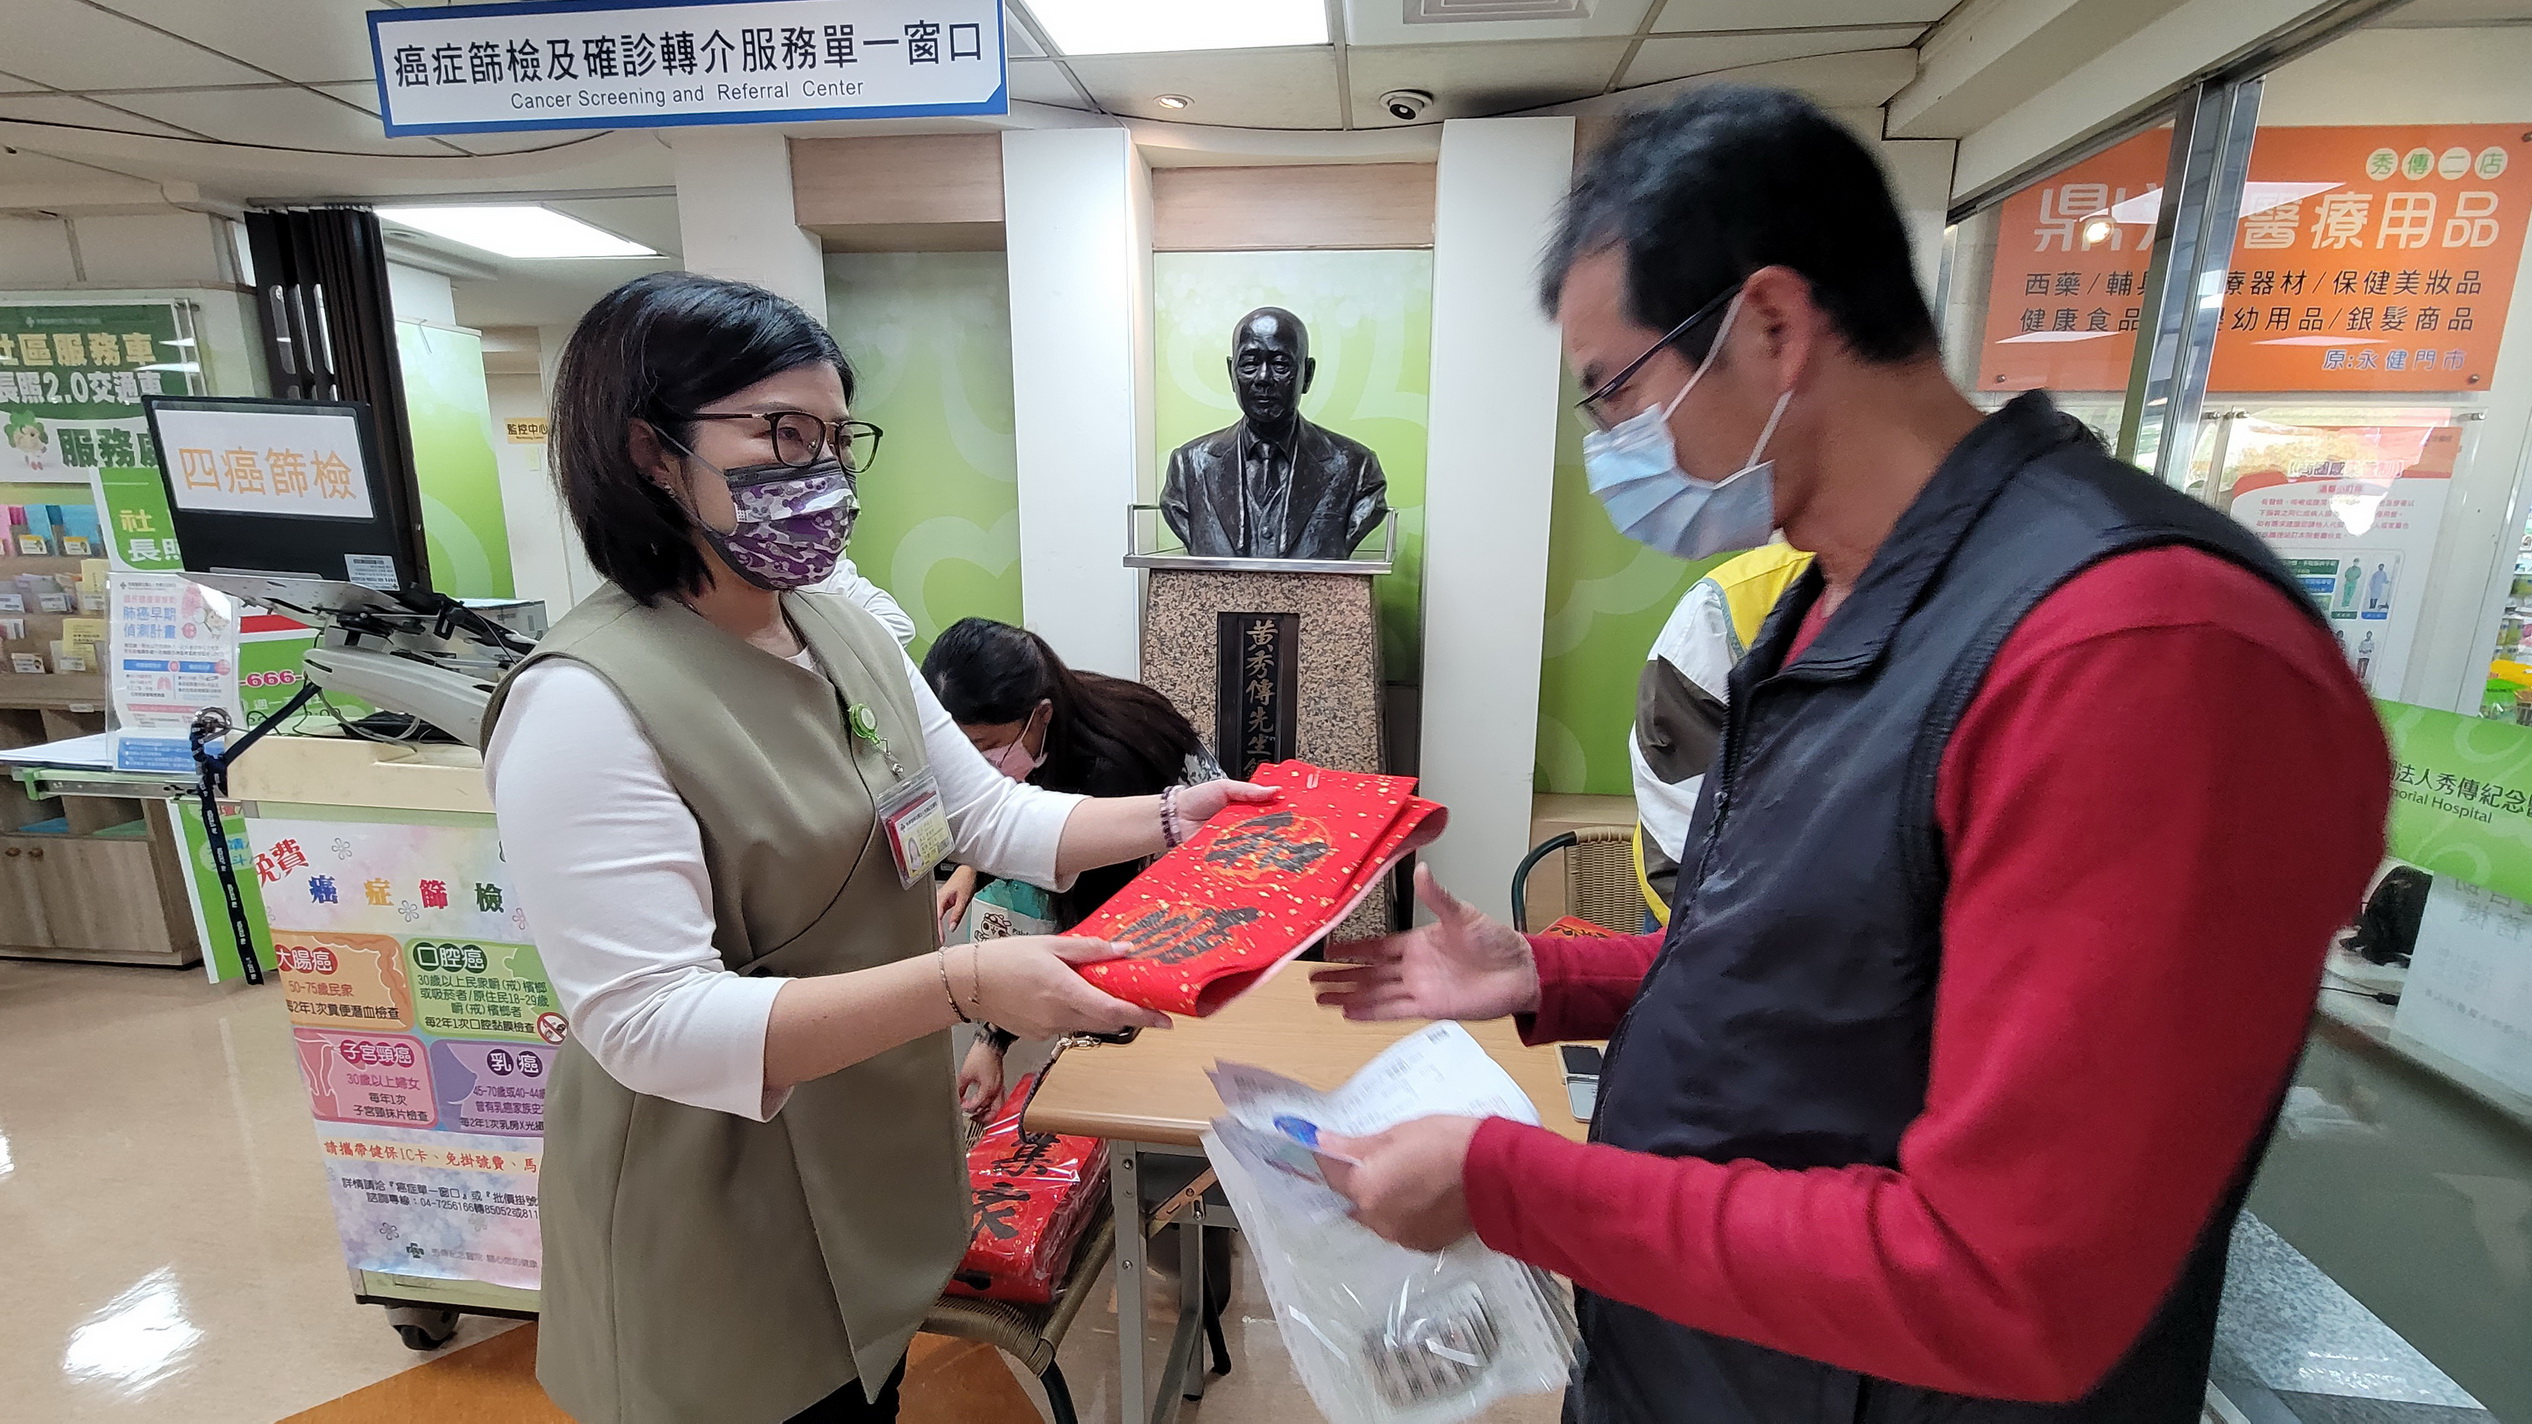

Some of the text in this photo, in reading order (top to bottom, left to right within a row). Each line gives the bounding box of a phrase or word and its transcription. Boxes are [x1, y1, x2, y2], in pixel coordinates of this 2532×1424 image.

[394, 20, 984, 88] 癌症篩檢及確診轉介服務單一窗口
[510, 79, 864, 112] Cancer Screening and Referral Center
[2370, 150, 2505, 176] 秀傳二店
[507, 423, 549, 436] 監控中心
[179, 446, 357, 500] 四癌篩檢
[123, 606, 177, 622] 肺癌早期
[1244, 619, 1279, 777] 黃秀傳先生
[2389, 760, 2532, 818] 法人秀傳紀念
[2431, 797, 2493, 824] Hospital
[252, 839, 310, 888] 免費
[276, 945, 336, 973] 大腸癌
[415, 944, 486, 971] 口腔癌
[341, 1042, 414, 1067] 子宮頸癌
[488, 1052, 541, 1074] 乳癌
[368, 1091, 407, 1106] 每年1次
